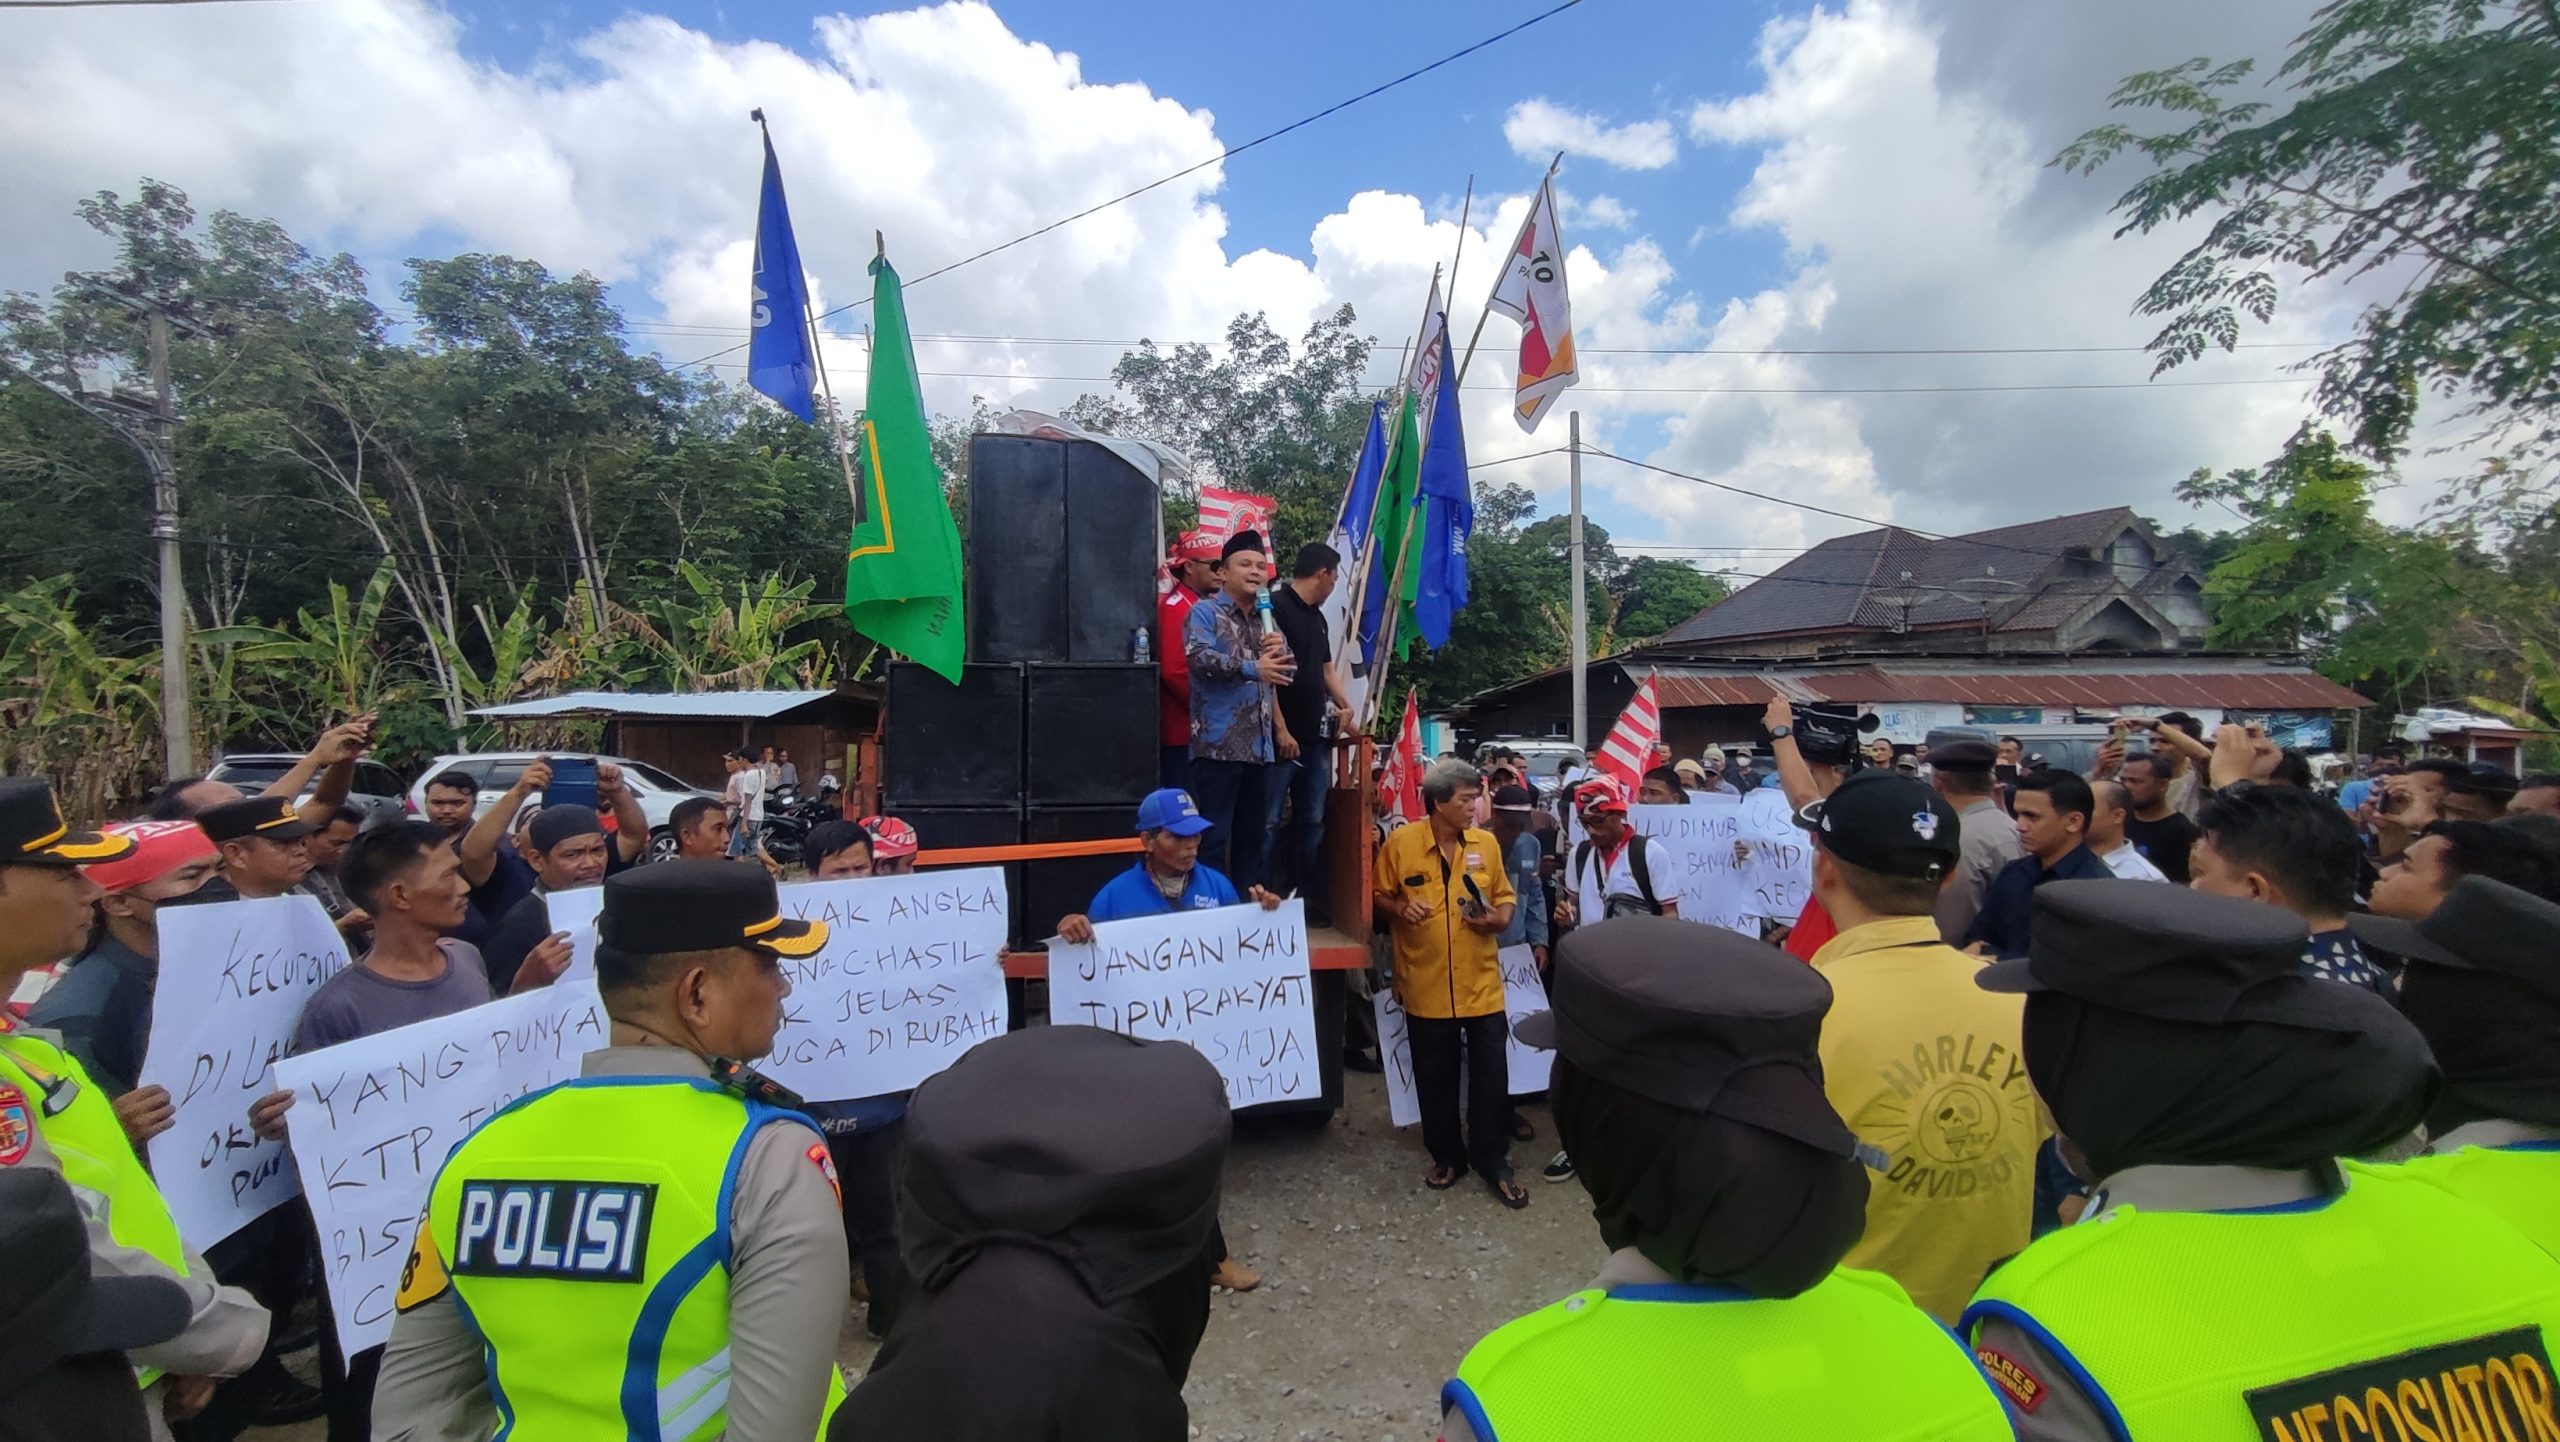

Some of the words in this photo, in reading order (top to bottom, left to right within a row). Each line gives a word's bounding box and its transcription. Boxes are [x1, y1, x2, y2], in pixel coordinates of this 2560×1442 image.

[1753, 841, 1811, 870] INDI
[780, 899, 870, 929] YAK
[888, 886, 1003, 926] ANGKA
[1078, 937, 1224, 982] JANGAN
[1237, 925, 1298, 961] KAU
[1183, 974, 1306, 1025] RAKYAT
[868, 1028, 893, 1056] DI
[907, 1010, 1001, 1049] RUBAH
[1212, 1026, 1305, 1068] SAJA
[311, 1041, 469, 1131] YANG
[491, 1006, 603, 1068] PUNYA
[1881, 1033, 2025, 1100] HARLEY
[200, 1122, 261, 1169] OK
[320, 1126, 434, 1214] KTP
[457, 1188, 645, 1272] POLISI
[1978, 1351, 2037, 1395] POLRES
[2271, 1353, 2560, 1442] OSIATOR
